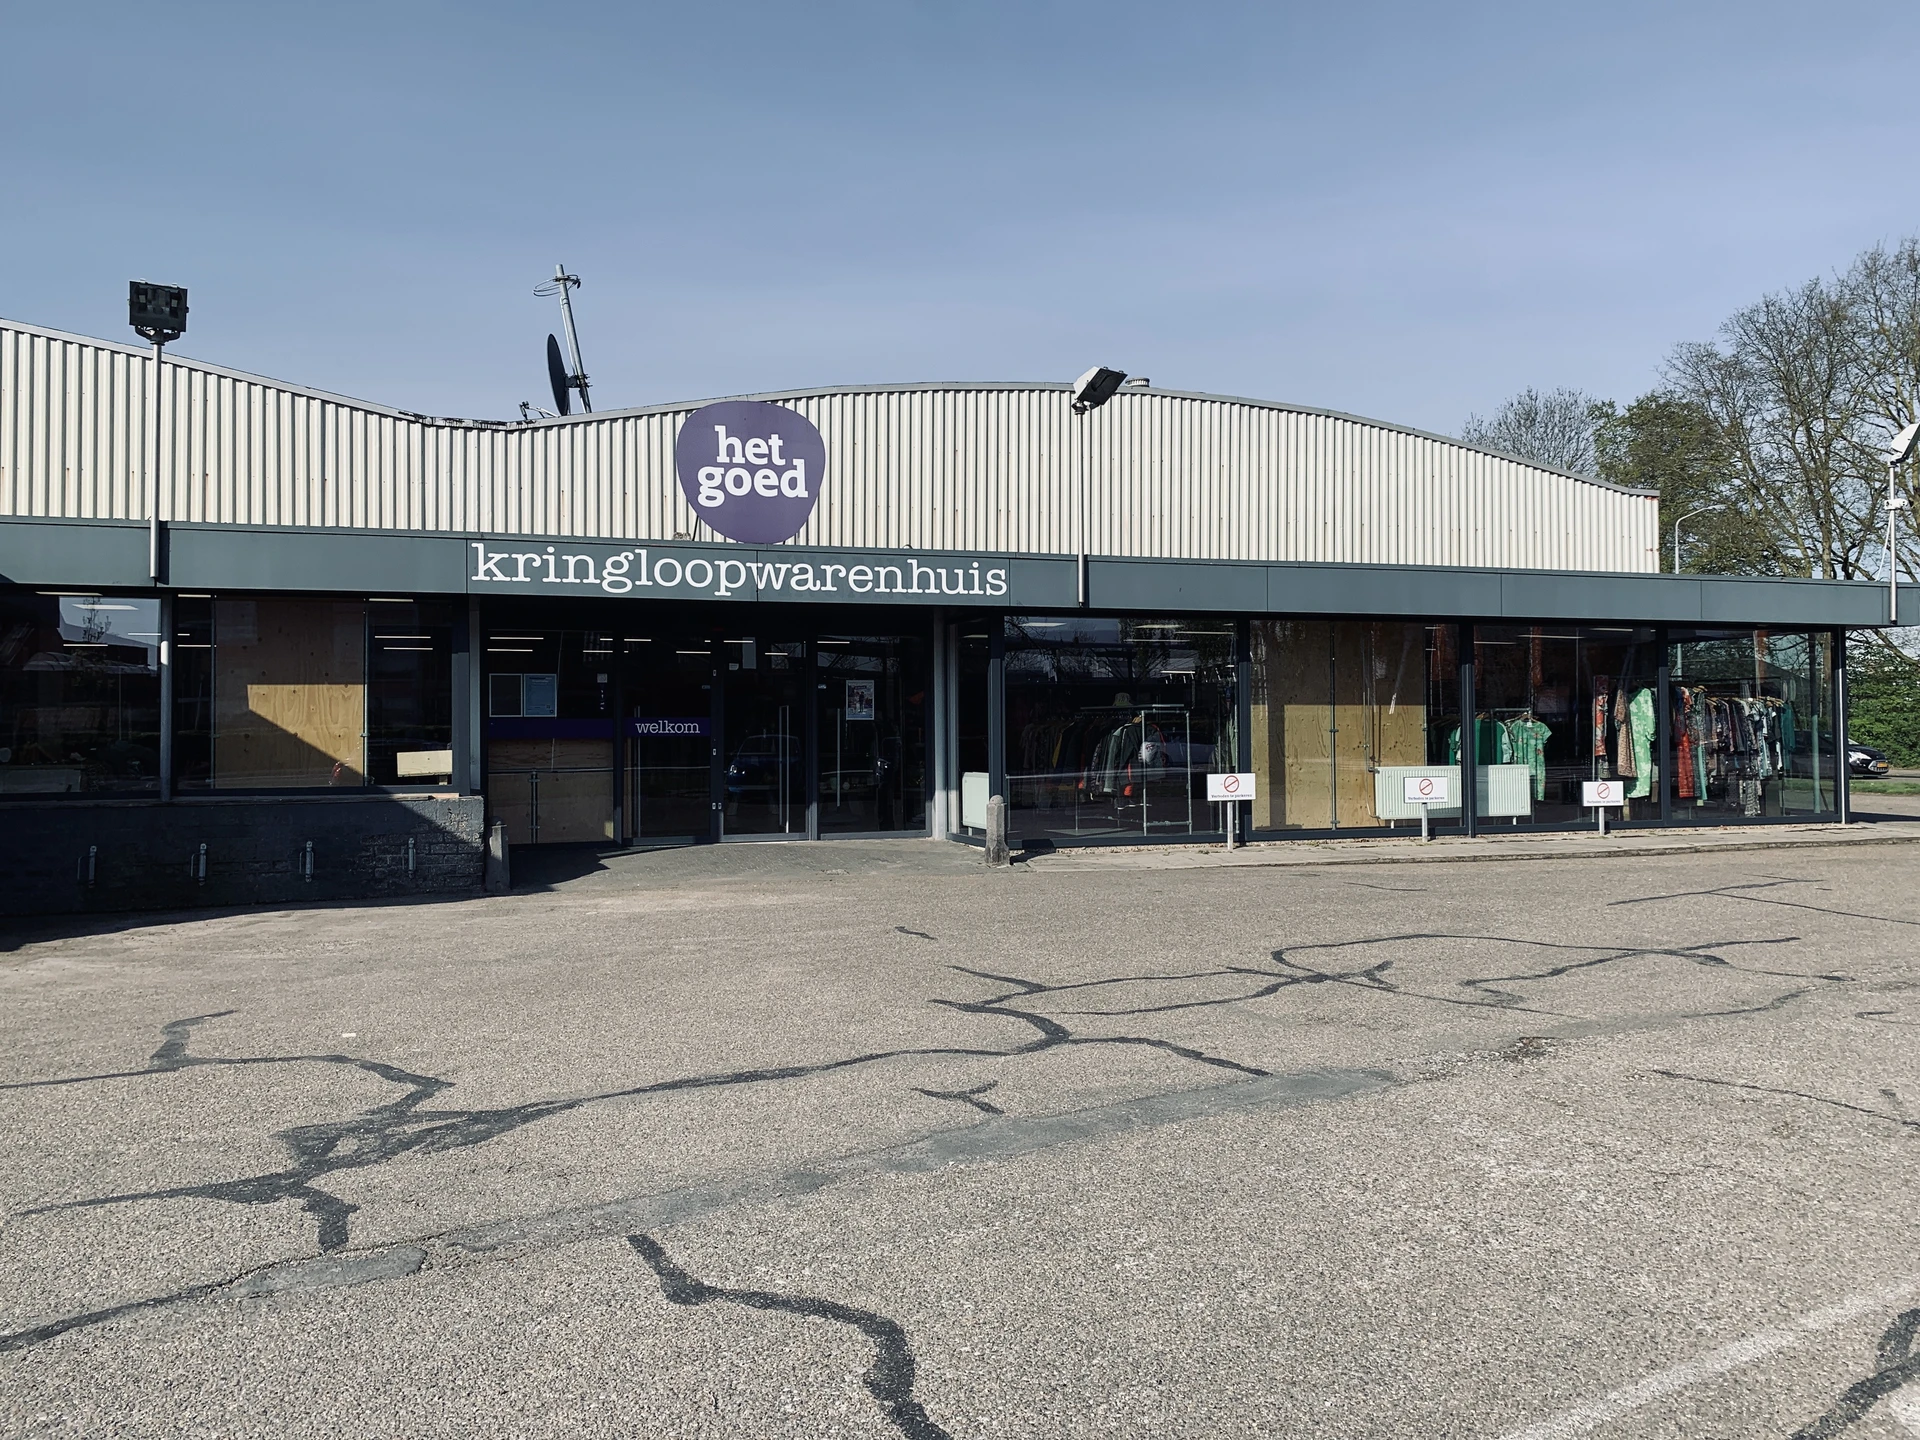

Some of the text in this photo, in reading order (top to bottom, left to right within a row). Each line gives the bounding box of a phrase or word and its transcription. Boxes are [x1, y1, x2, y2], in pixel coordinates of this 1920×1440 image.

[714, 425, 786, 466] het
[697, 458, 809, 508] goed
[470, 542, 1008, 597] kringloopwarenhuis
[635, 720, 701, 734] welkom
